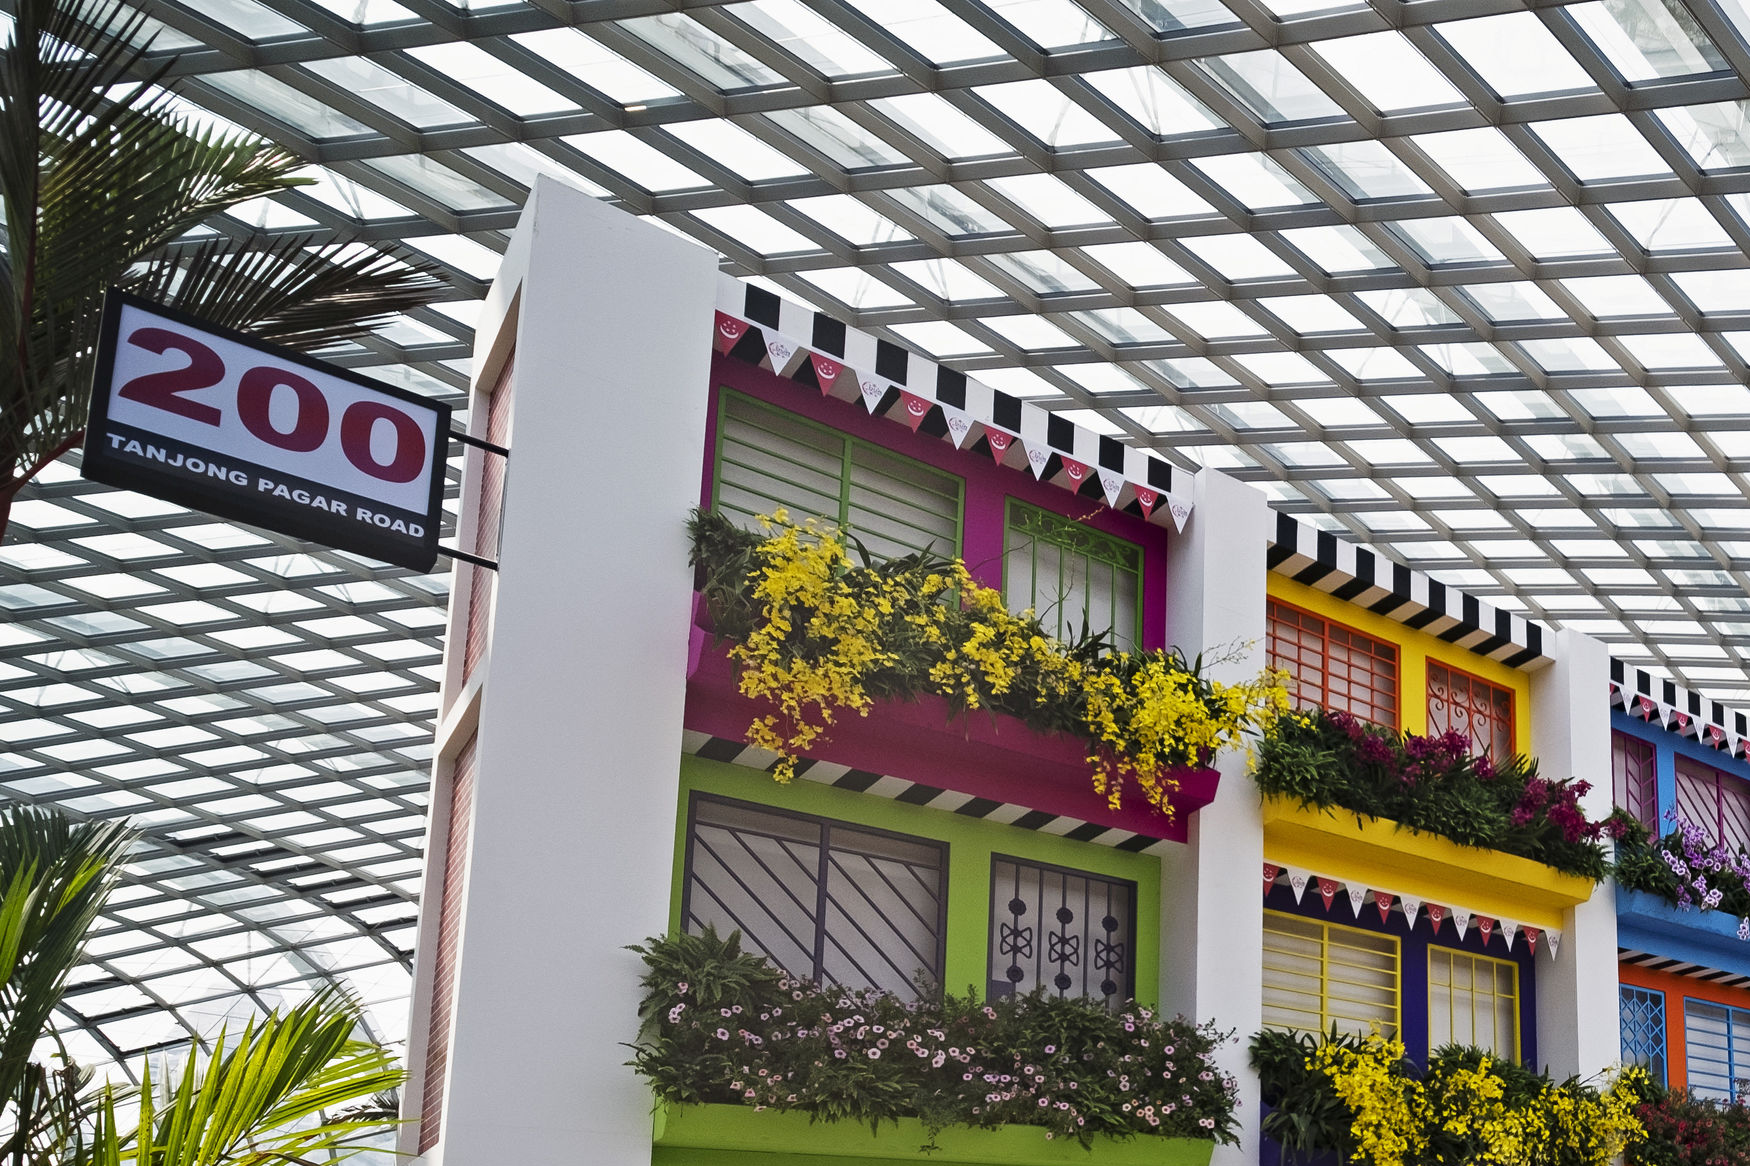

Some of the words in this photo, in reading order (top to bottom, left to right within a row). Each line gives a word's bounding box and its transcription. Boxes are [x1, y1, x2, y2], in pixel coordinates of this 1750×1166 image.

[118, 327, 426, 484] 200
[106, 432, 249, 487] TANJONG
[258, 479, 348, 517] PAGAR
[356, 507, 425, 539] ROAD
